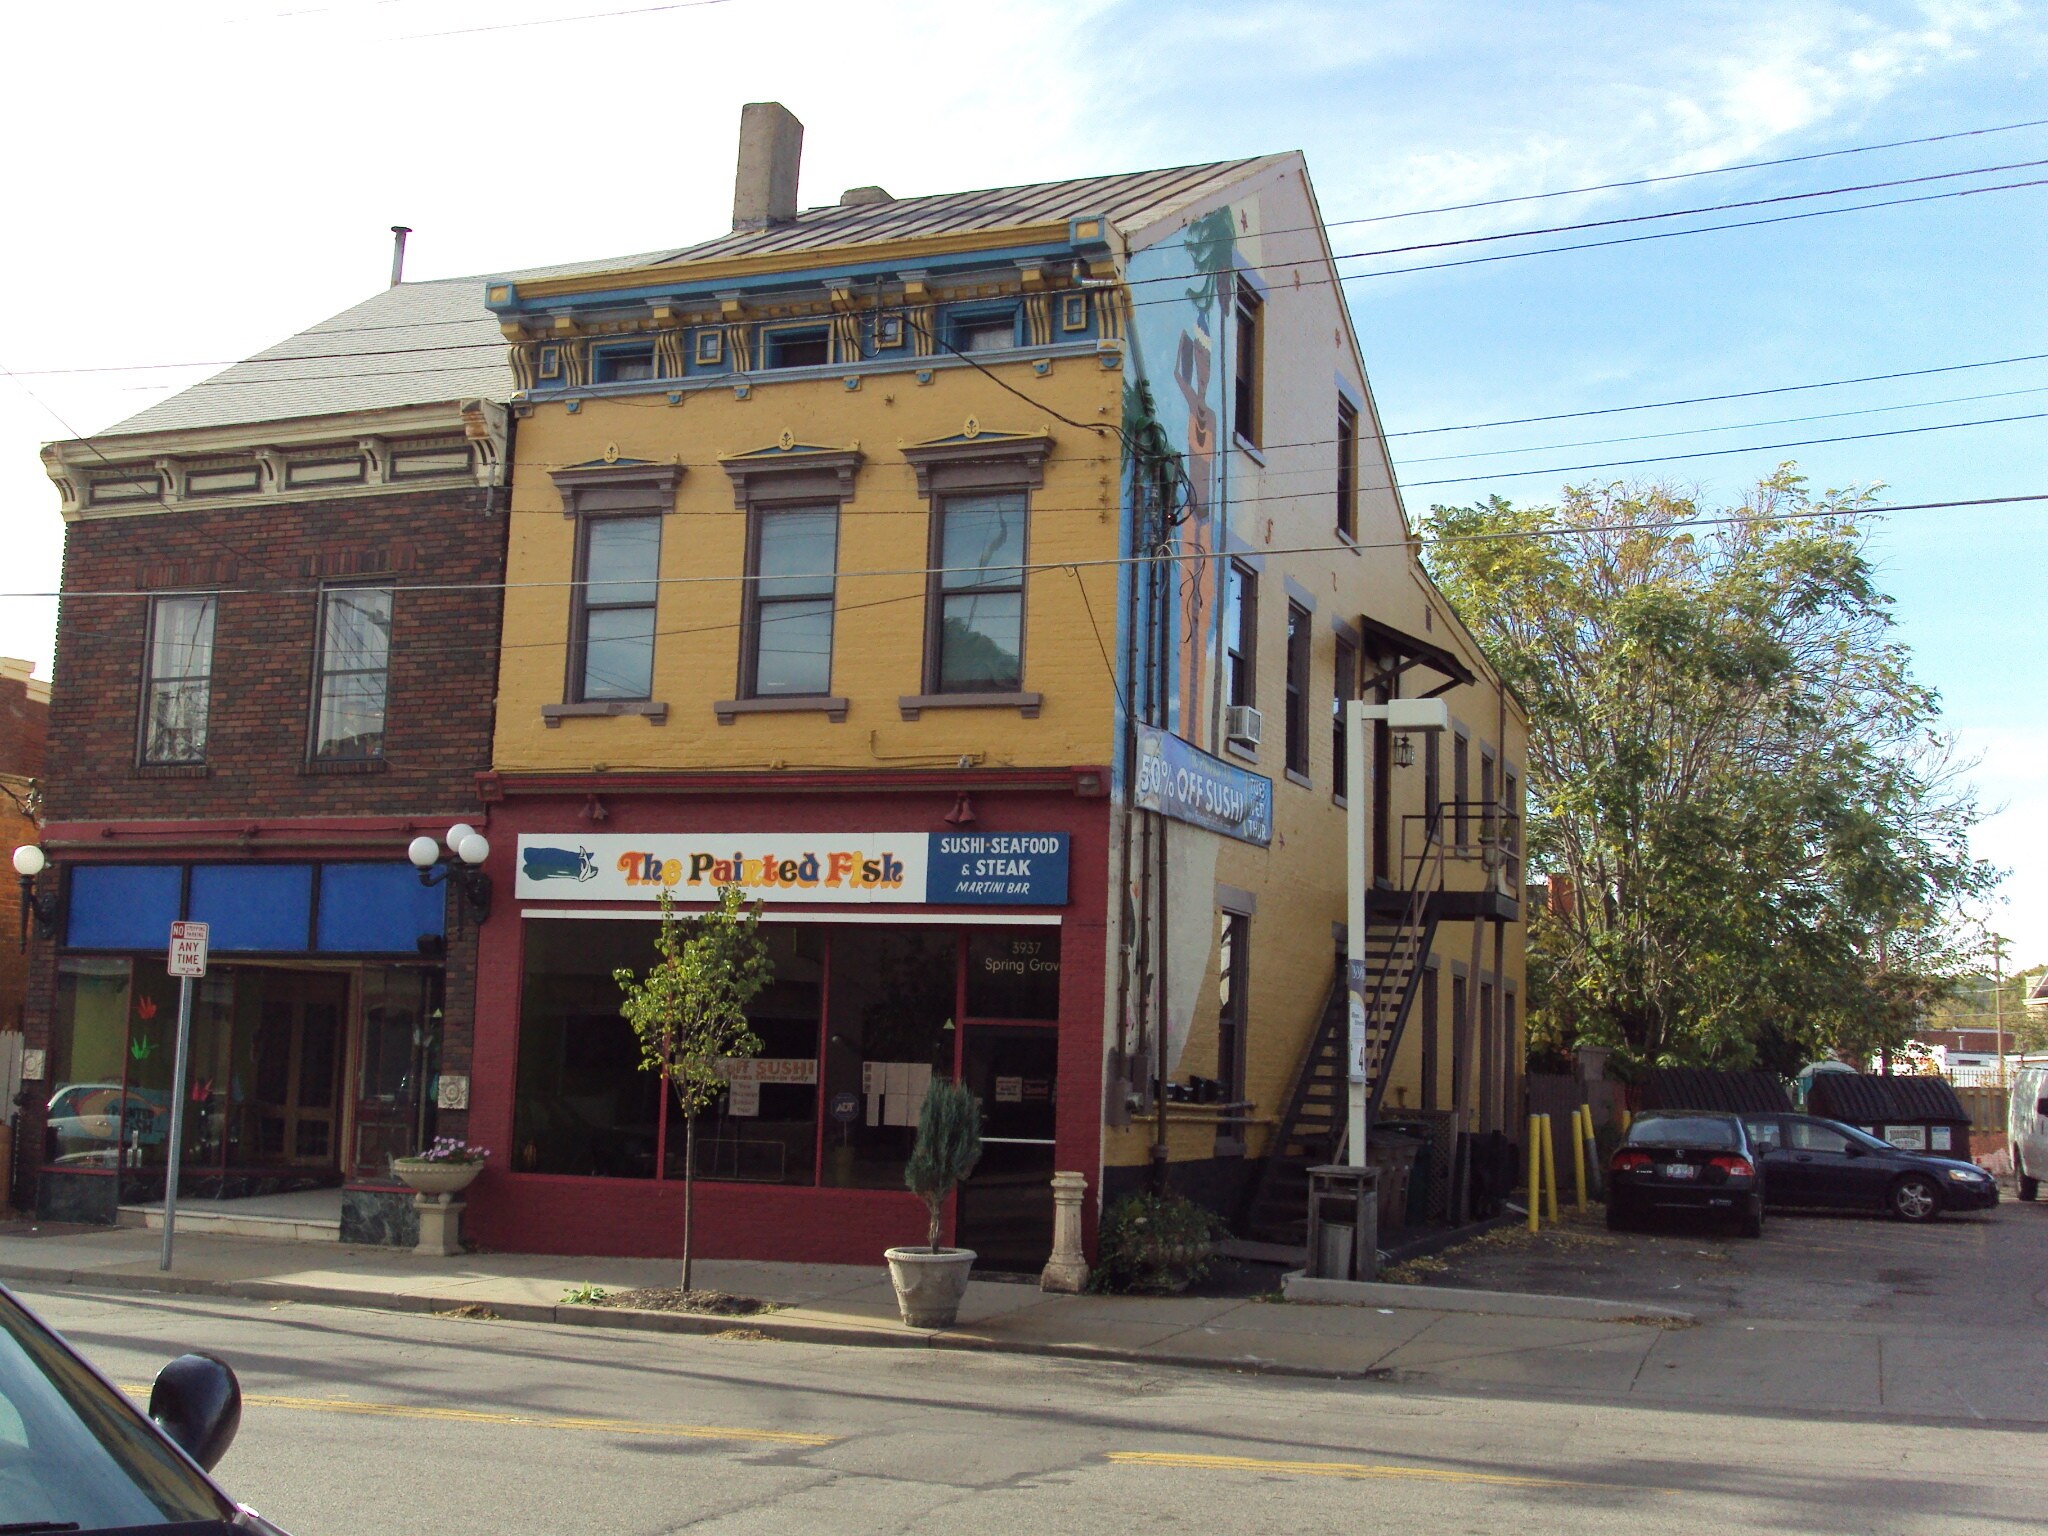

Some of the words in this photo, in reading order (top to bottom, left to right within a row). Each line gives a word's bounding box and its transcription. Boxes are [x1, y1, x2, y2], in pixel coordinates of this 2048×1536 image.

[1141, 754, 1175, 797] 50%
[1176, 767, 1202, 807] OFF
[1205, 778, 1244, 822] SUSHI
[1247, 819, 1267, 841] THUR
[941, 837, 985, 854] SUSHI
[990, 837, 1059, 854] SEAFOOD
[617, 851, 682, 886] The
[687, 847, 820, 888] Painted
[825, 846, 904, 889] Fish
[961, 863, 970, 876] &
[975, 859, 1031, 876] STEAK
[955, 881, 1004, 895] MARTINI
[1006, 882, 1030, 895] BAR
[172, 925, 184, 937] NO
[178, 941, 199, 953] ANY
[1012, 942, 1041, 954] 3937
[177, 953, 199, 965] TIME
[985, 958, 1024, 974] Spring
[755, 1060, 815, 1075] SUSHI
[836, 1102, 855, 1113] ADT
